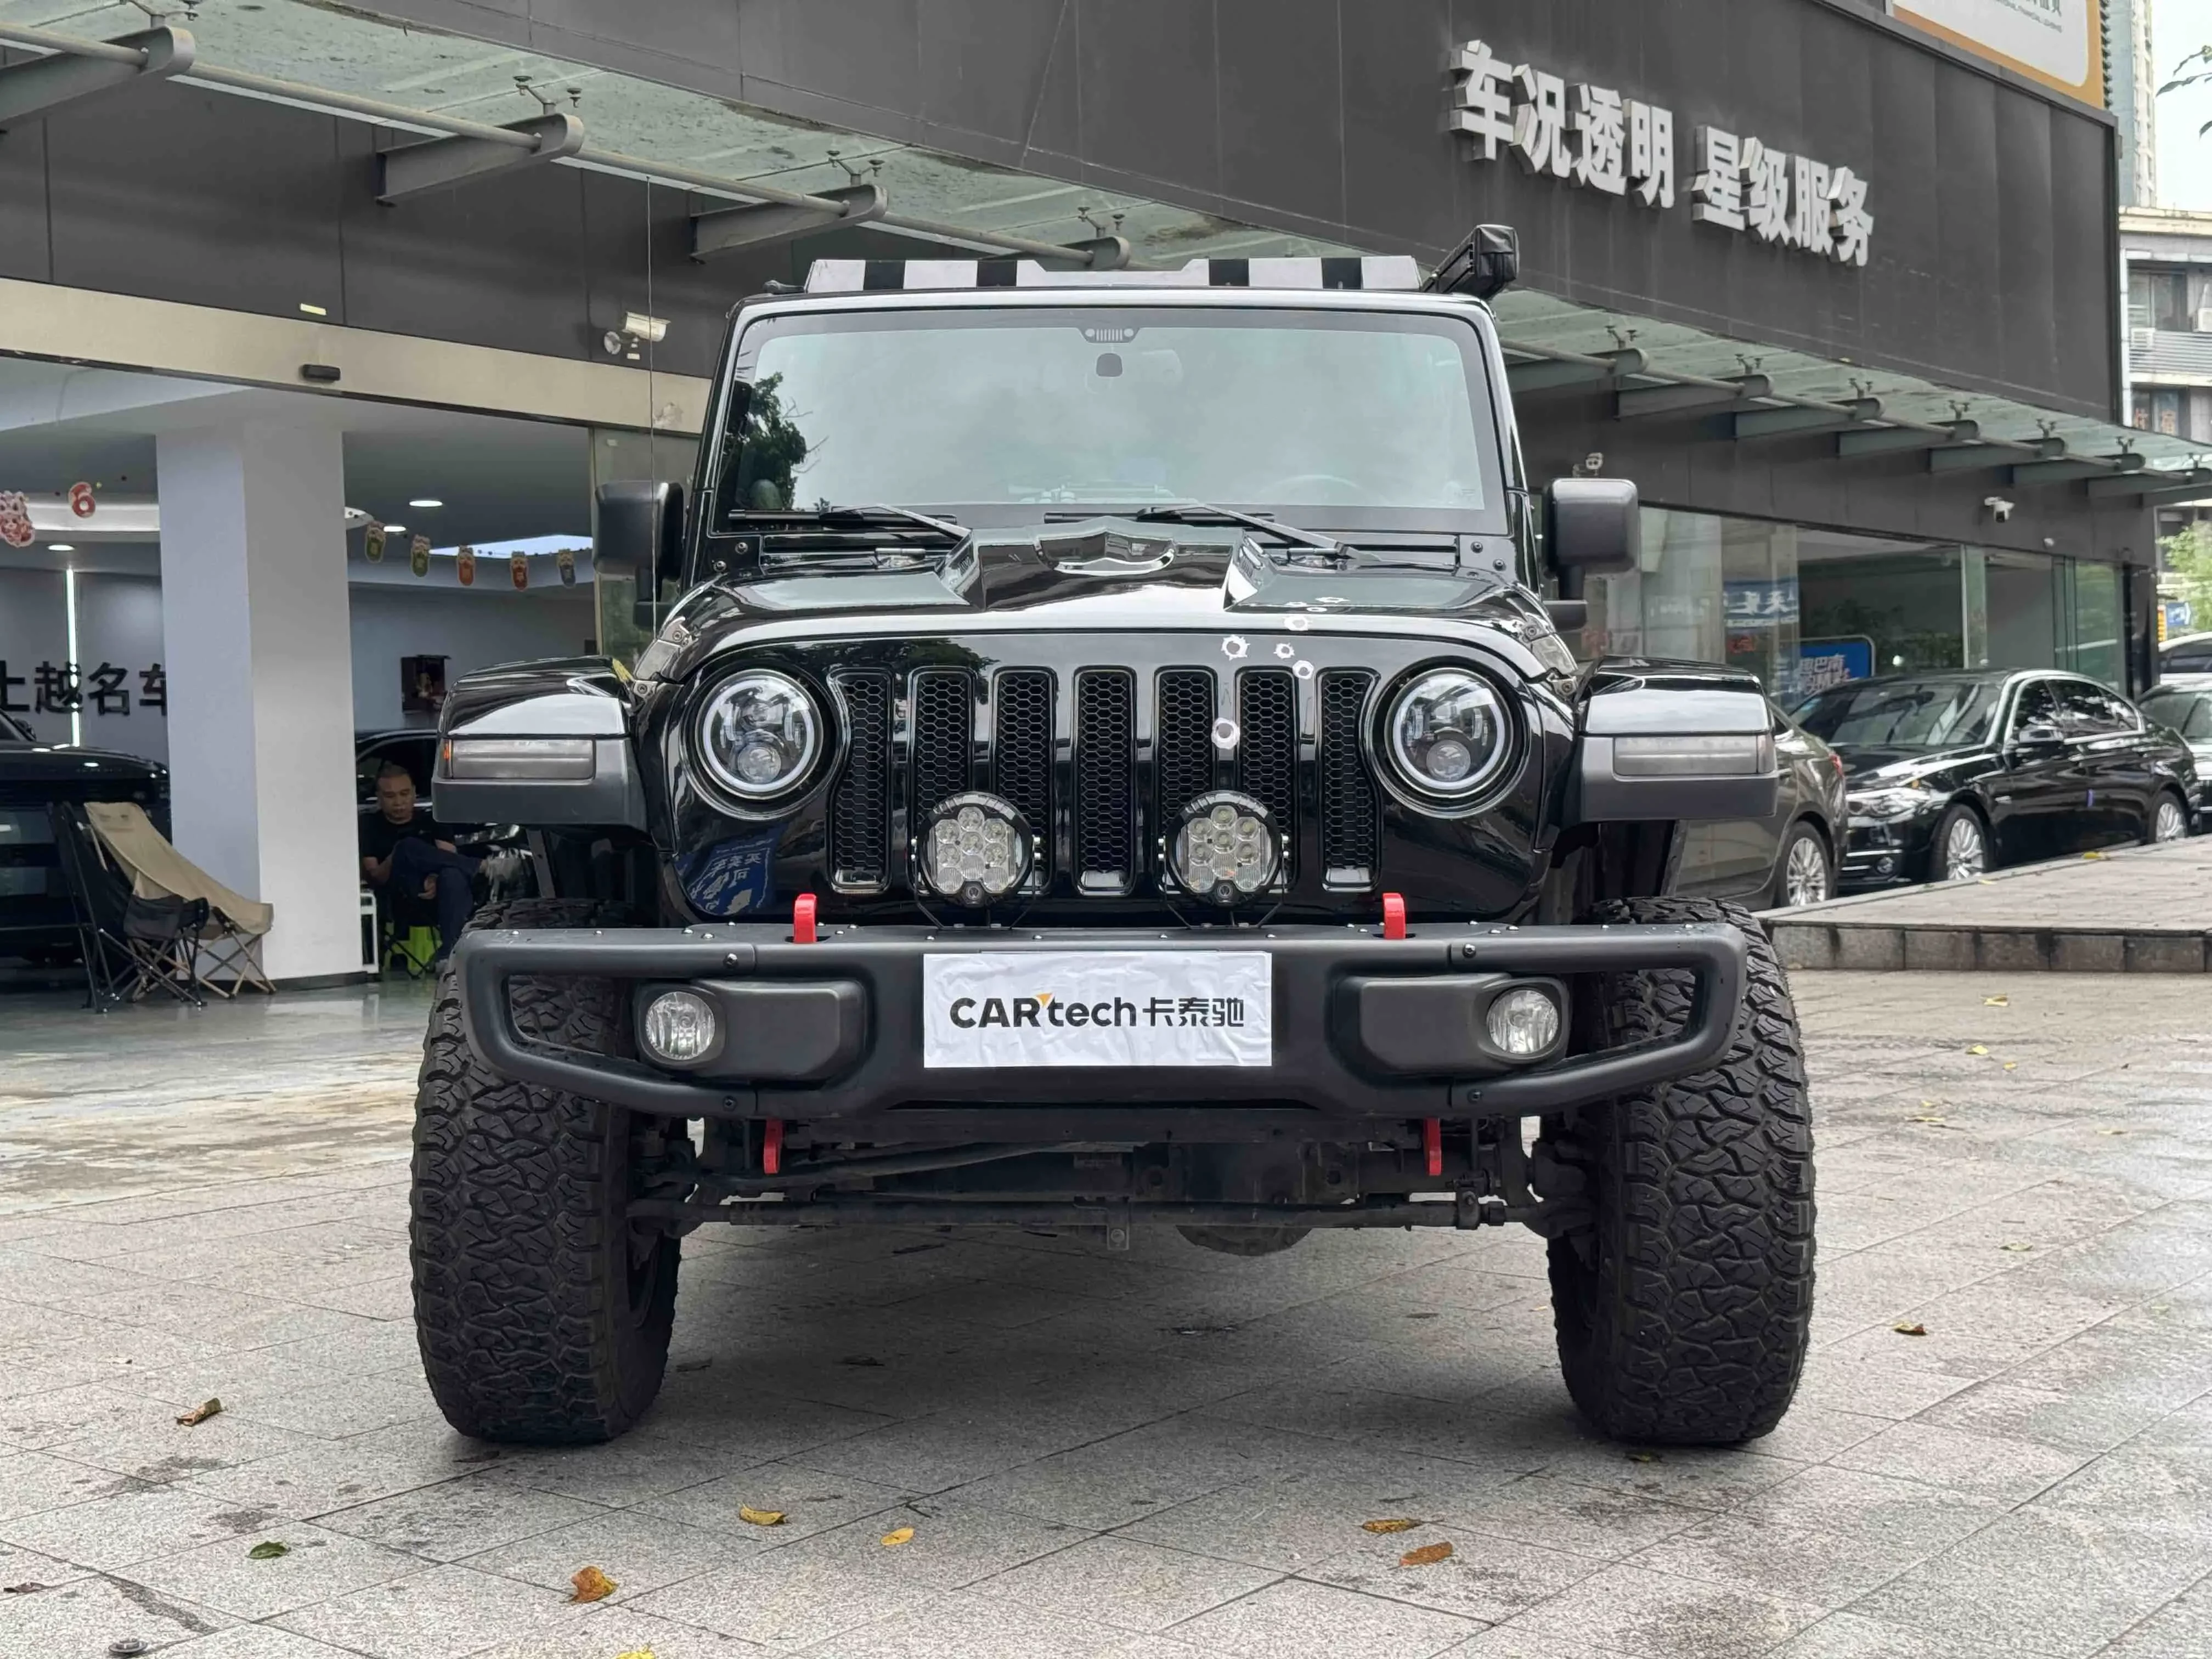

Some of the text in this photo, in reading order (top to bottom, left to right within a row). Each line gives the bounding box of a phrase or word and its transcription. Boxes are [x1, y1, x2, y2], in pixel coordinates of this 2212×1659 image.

[1451, 40, 1874, 267] 车况透明 星级服务
[950, 994, 1244, 1029] CARtech 卡泰驰
